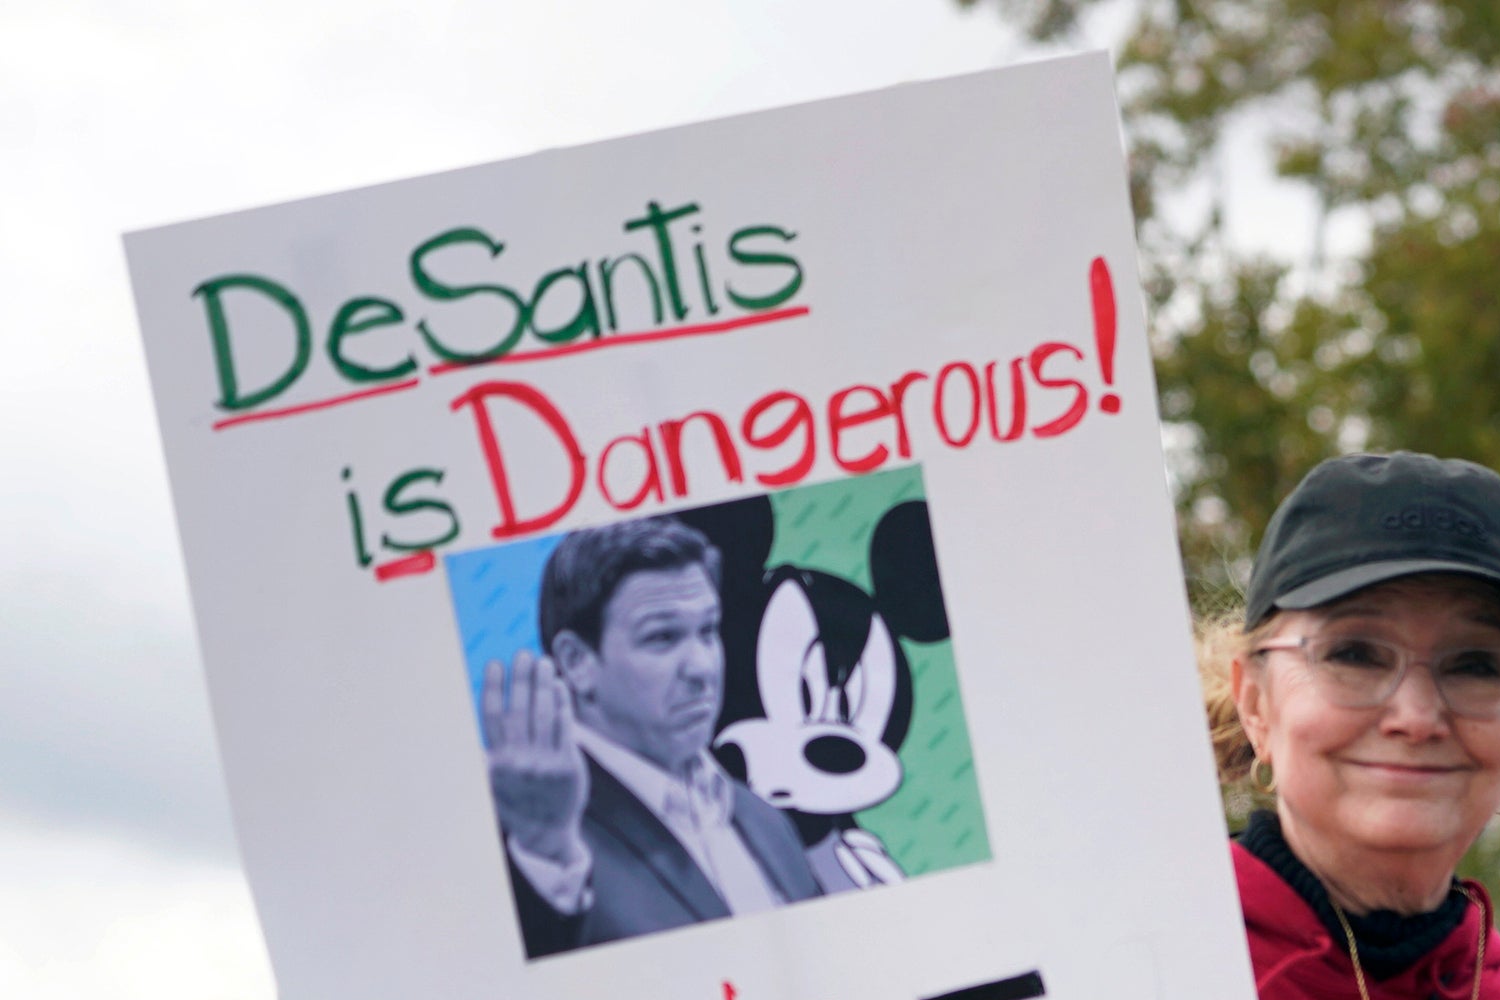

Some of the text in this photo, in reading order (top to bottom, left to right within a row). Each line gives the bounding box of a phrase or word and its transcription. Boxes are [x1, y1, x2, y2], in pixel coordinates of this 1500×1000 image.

[194, 201, 804, 411] DeSantis
[339, 256, 1123, 568] is Dangerous!
